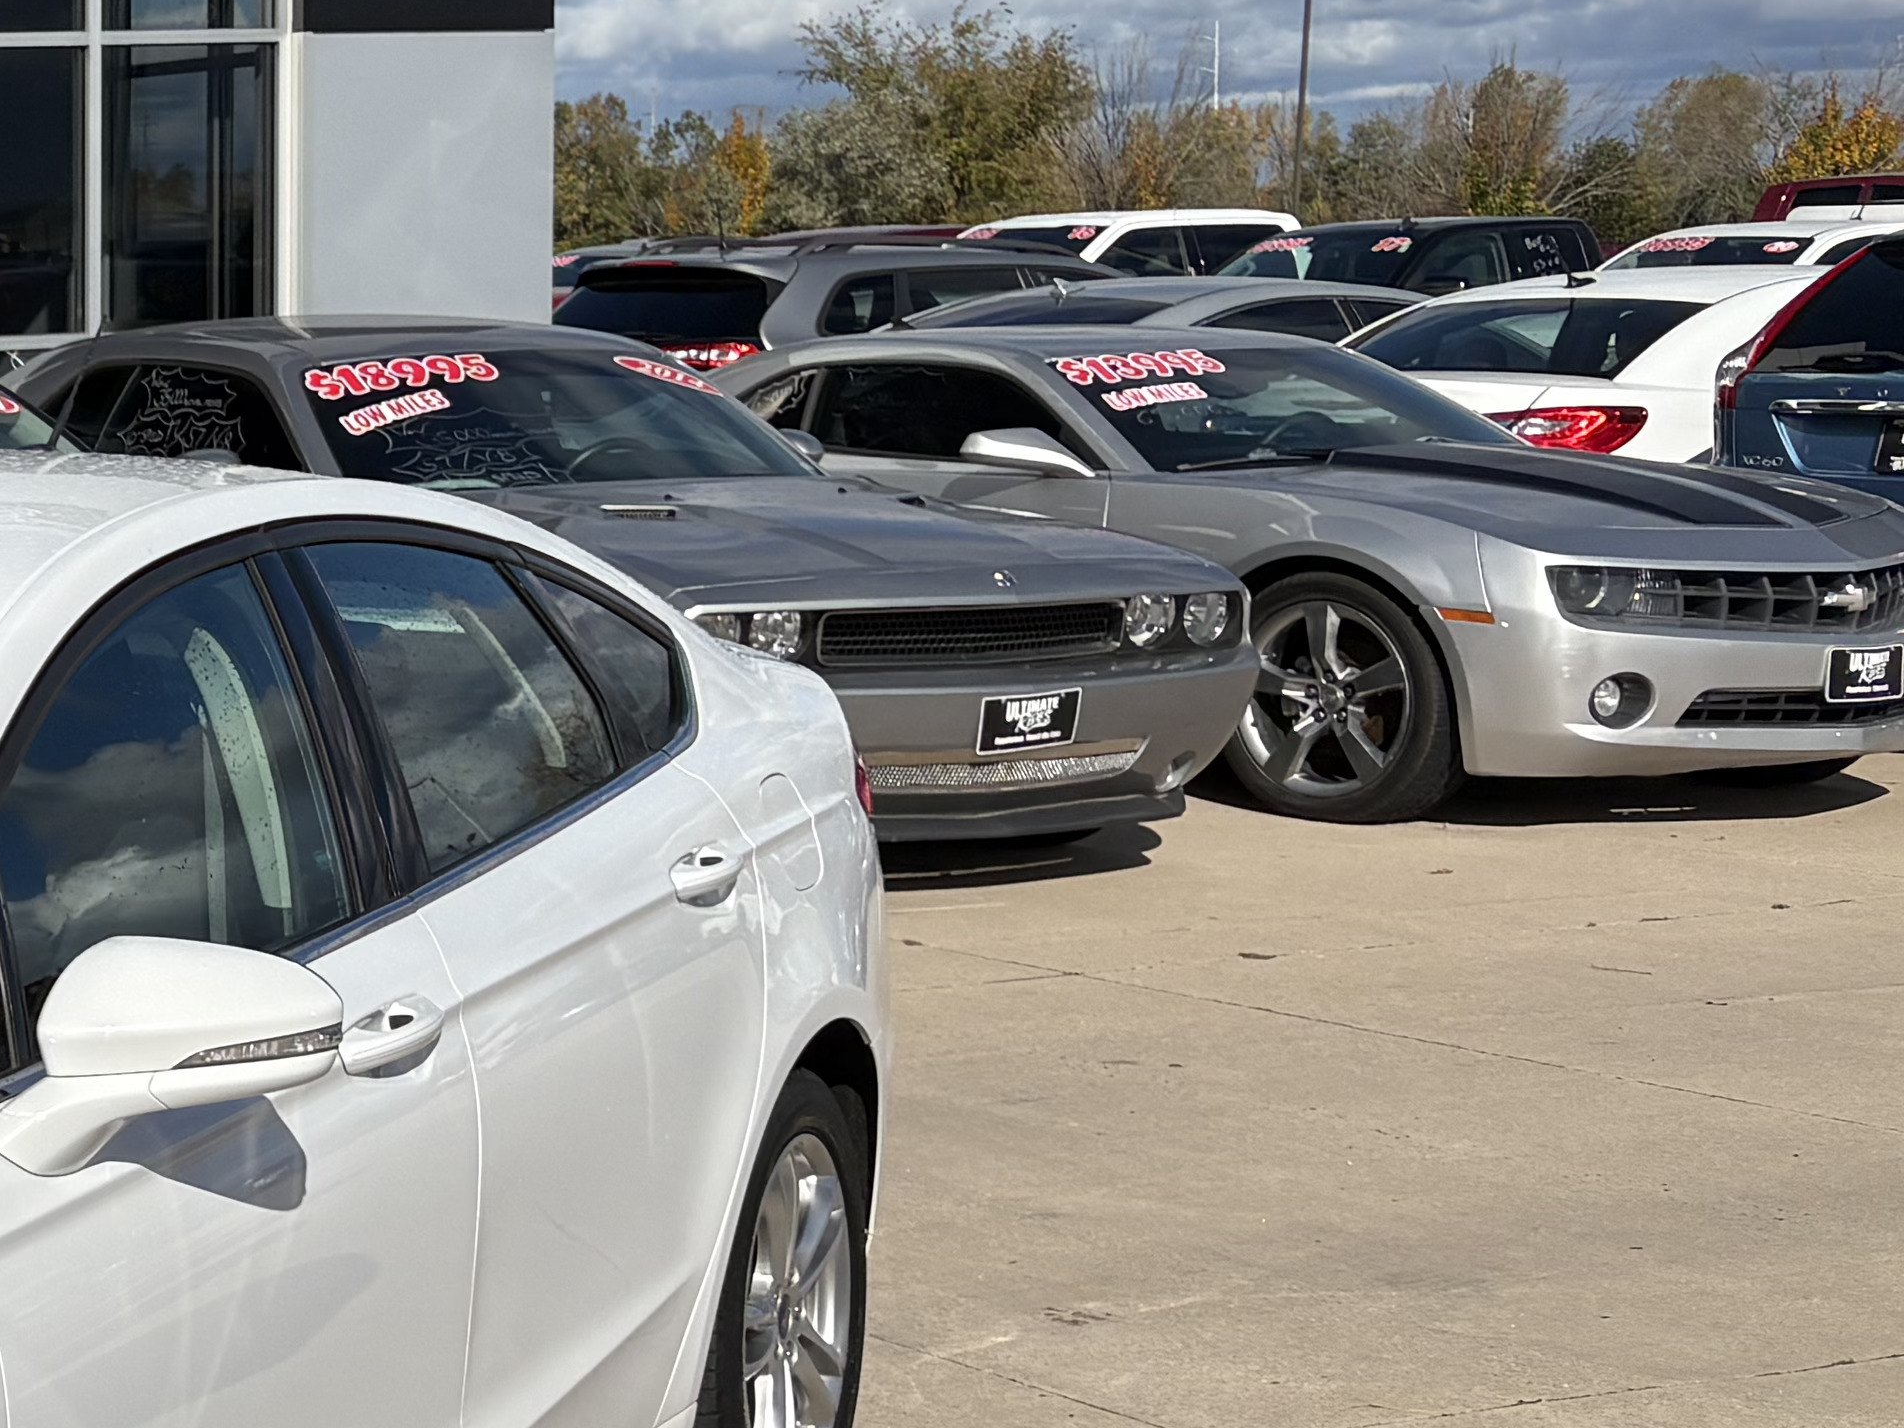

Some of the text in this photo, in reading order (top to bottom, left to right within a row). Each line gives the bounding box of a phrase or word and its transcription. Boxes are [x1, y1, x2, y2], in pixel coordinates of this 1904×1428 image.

[305, 354, 500, 400] $18995
[1056, 349, 1226, 385] $13995
[341, 404, 388, 434] LOW
[390, 389, 450, 418] MILES
